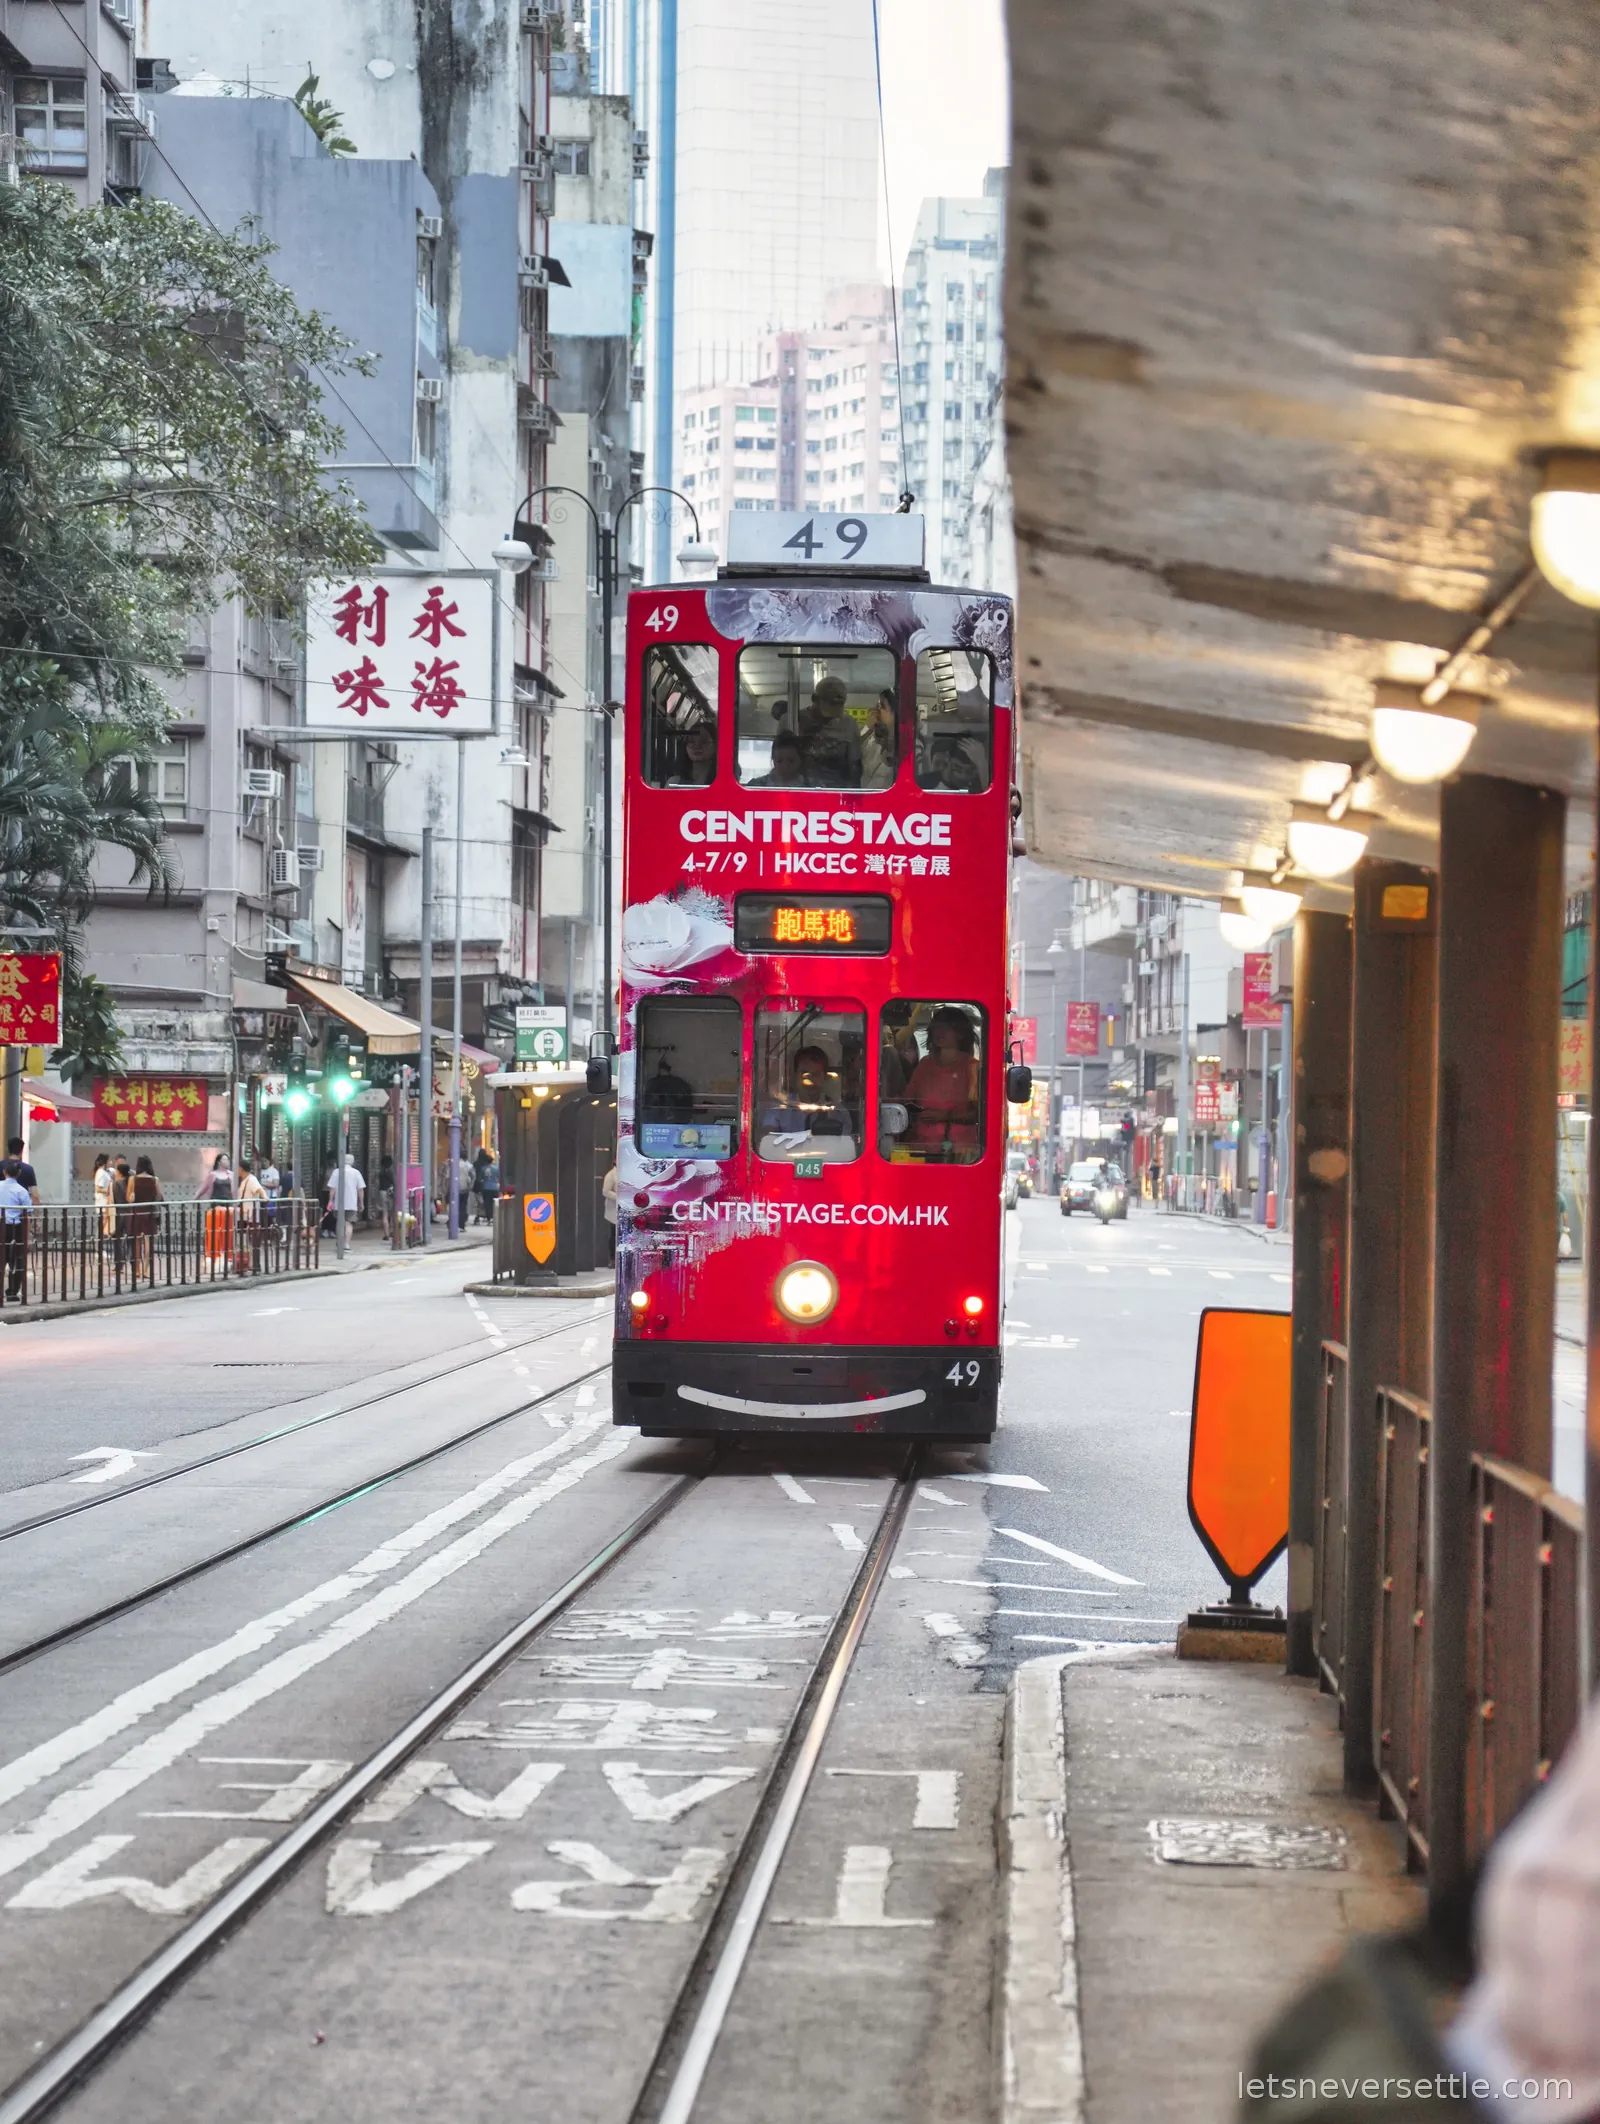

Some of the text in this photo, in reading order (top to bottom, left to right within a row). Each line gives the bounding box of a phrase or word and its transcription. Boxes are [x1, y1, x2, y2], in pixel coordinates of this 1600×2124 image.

[782, 518, 868, 559] 49
[644, 605, 679, 632] 49
[974, 609, 1009, 634] 49
[680, 810, 952, 846] CENTRESTAGE
[681, 852, 951, 876] 4-7/9 HKCEC 灣仔會展
[775, 908, 853, 942] 跑馬地
[101, 1079, 202, 1108] 永利海味
[796, 1163, 820, 1175] 045
[672, 1200, 949, 1226] CENTRESTAGE.COM.HK
[945, 1360, 980, 1387] 49
[137, 1757, 962, 1830] LANE
[3, 1834, 936, 1927] TRAM
